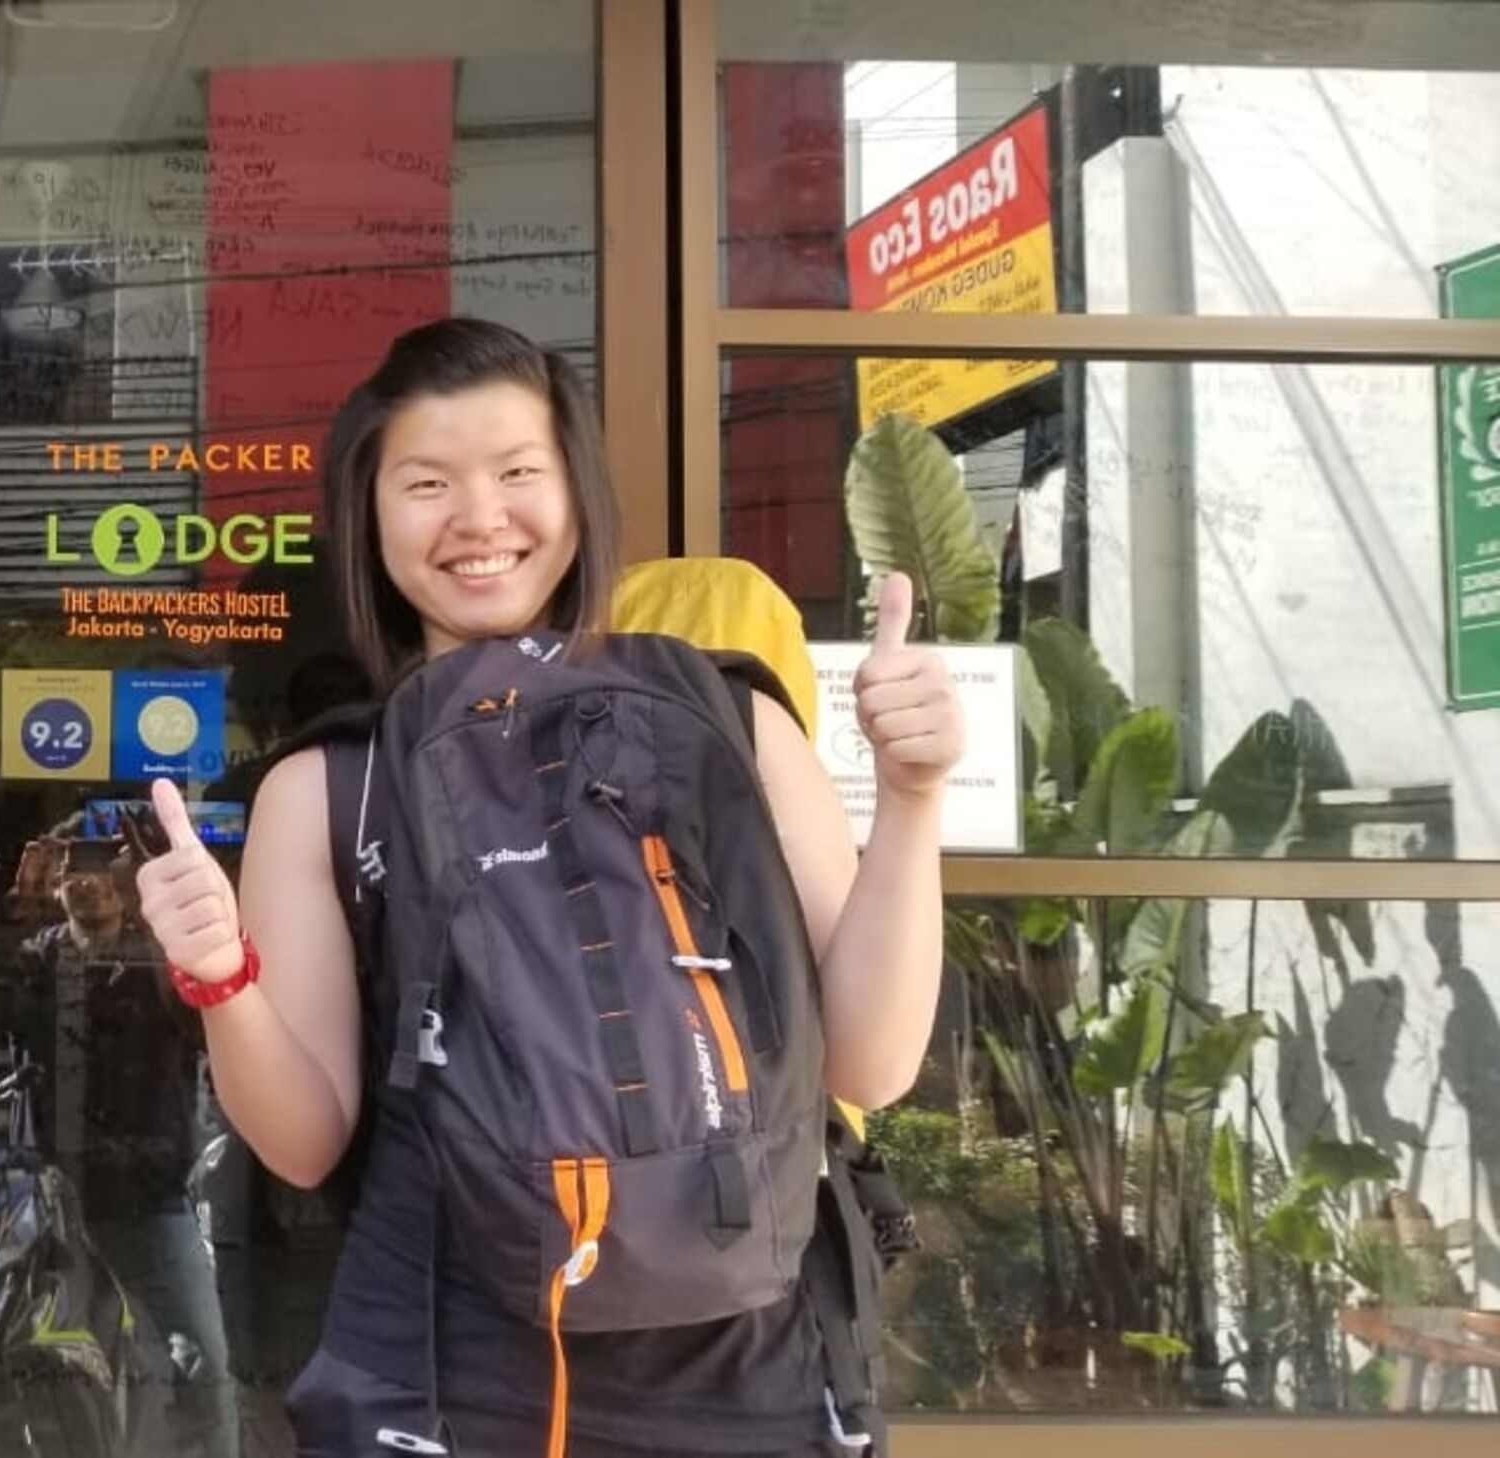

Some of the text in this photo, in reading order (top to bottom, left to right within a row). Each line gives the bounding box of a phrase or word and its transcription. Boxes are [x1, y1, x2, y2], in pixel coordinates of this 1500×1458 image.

[48, 443, 314, 471] THE PACKER
[48, 504, 314, 575] LODGE
[62, 587, 291, 618] THE BACKPACKERS HOSTEL
[67, 617, 145, 637] Jakarta
[163, 619, 283, 644] Yogyakarta
[30, 721, 83, 749] 9.2
